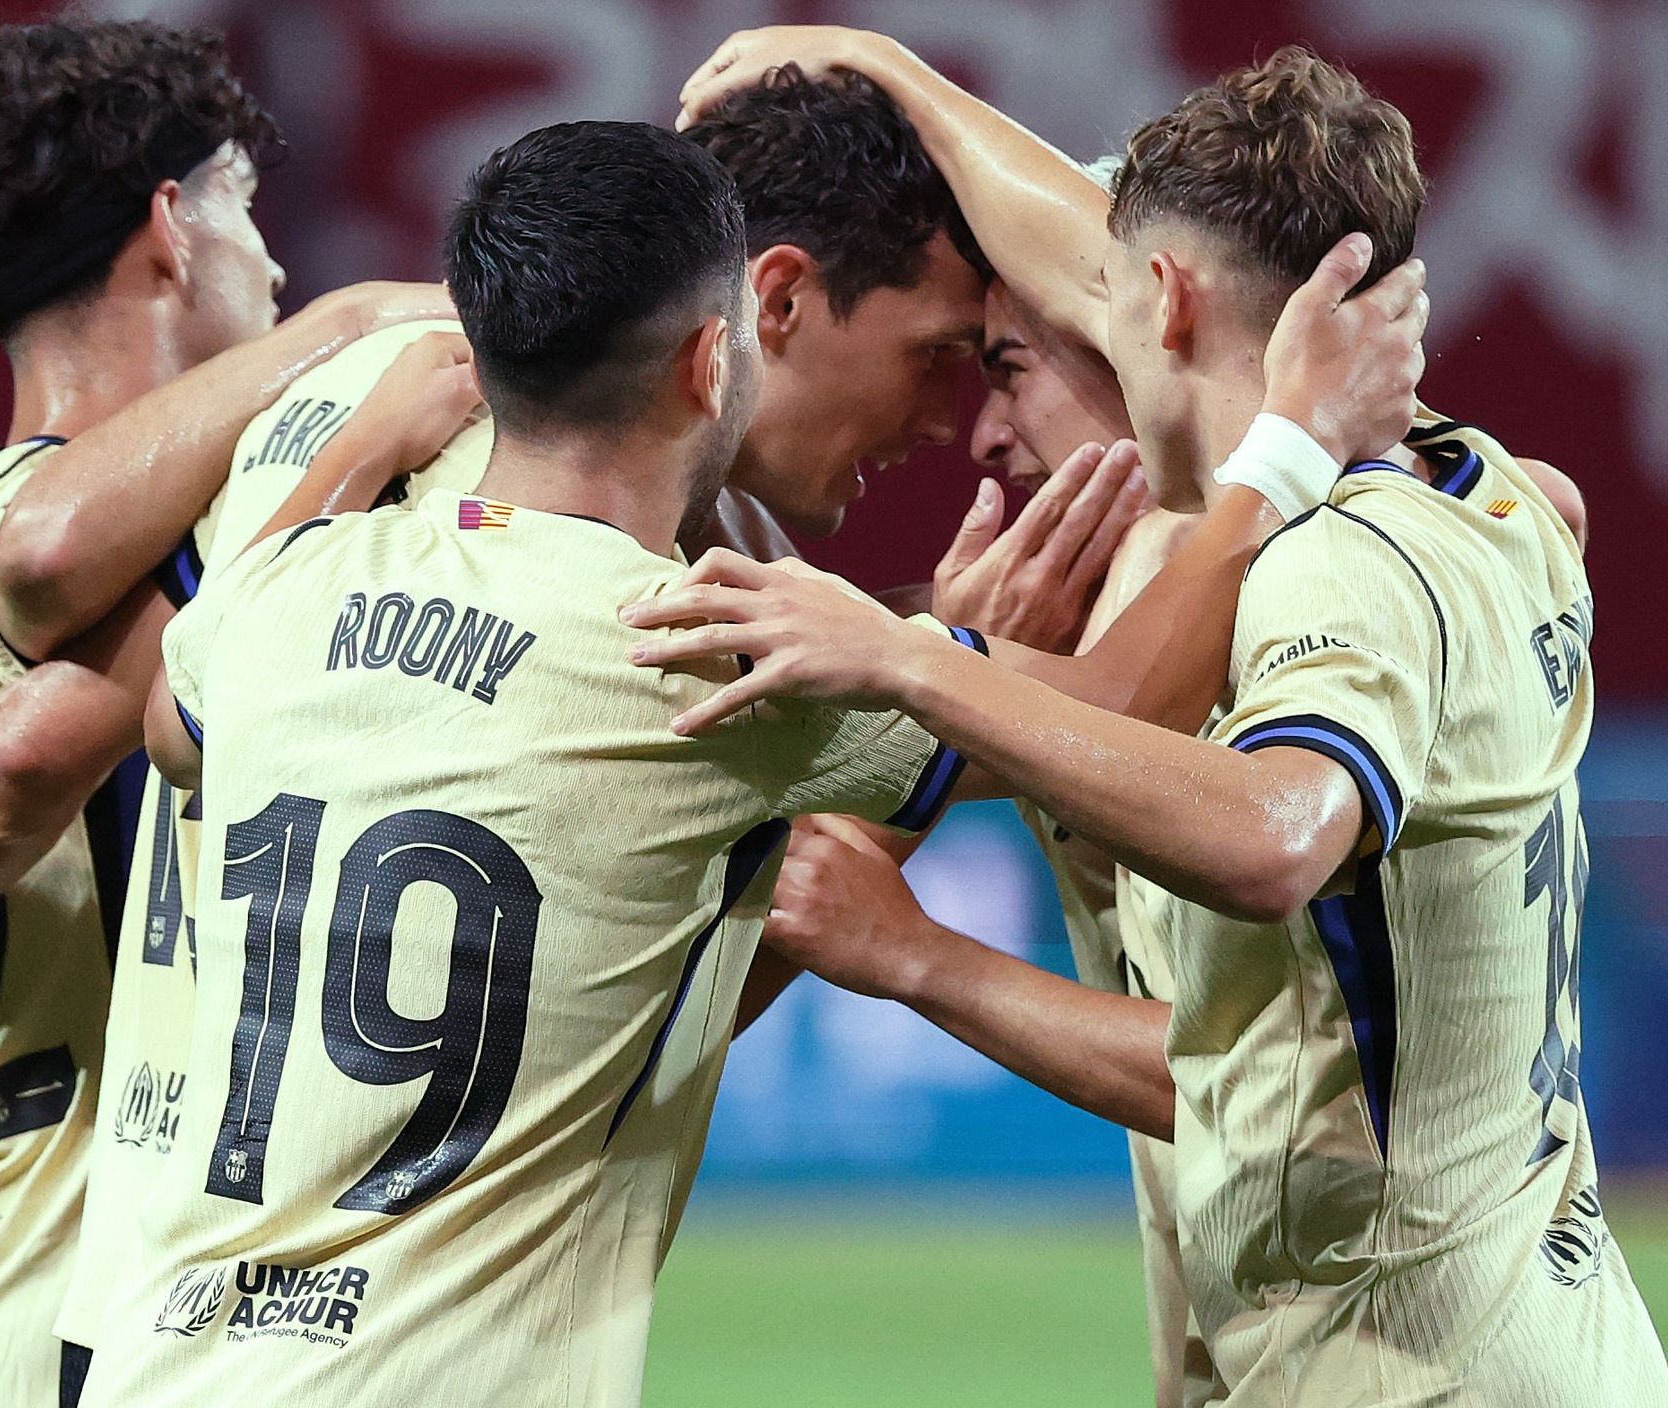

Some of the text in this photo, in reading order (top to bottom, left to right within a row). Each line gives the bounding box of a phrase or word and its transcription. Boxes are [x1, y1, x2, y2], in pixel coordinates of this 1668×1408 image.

[326, 591, 538, 706] ROONY
[204, 792, 545, 1217] 19
[235, 1260, 370, 1301] UNHCR
[227, 1296, 359, 1335] ACNUR
[300, 1327, 349, 1349] Agency
